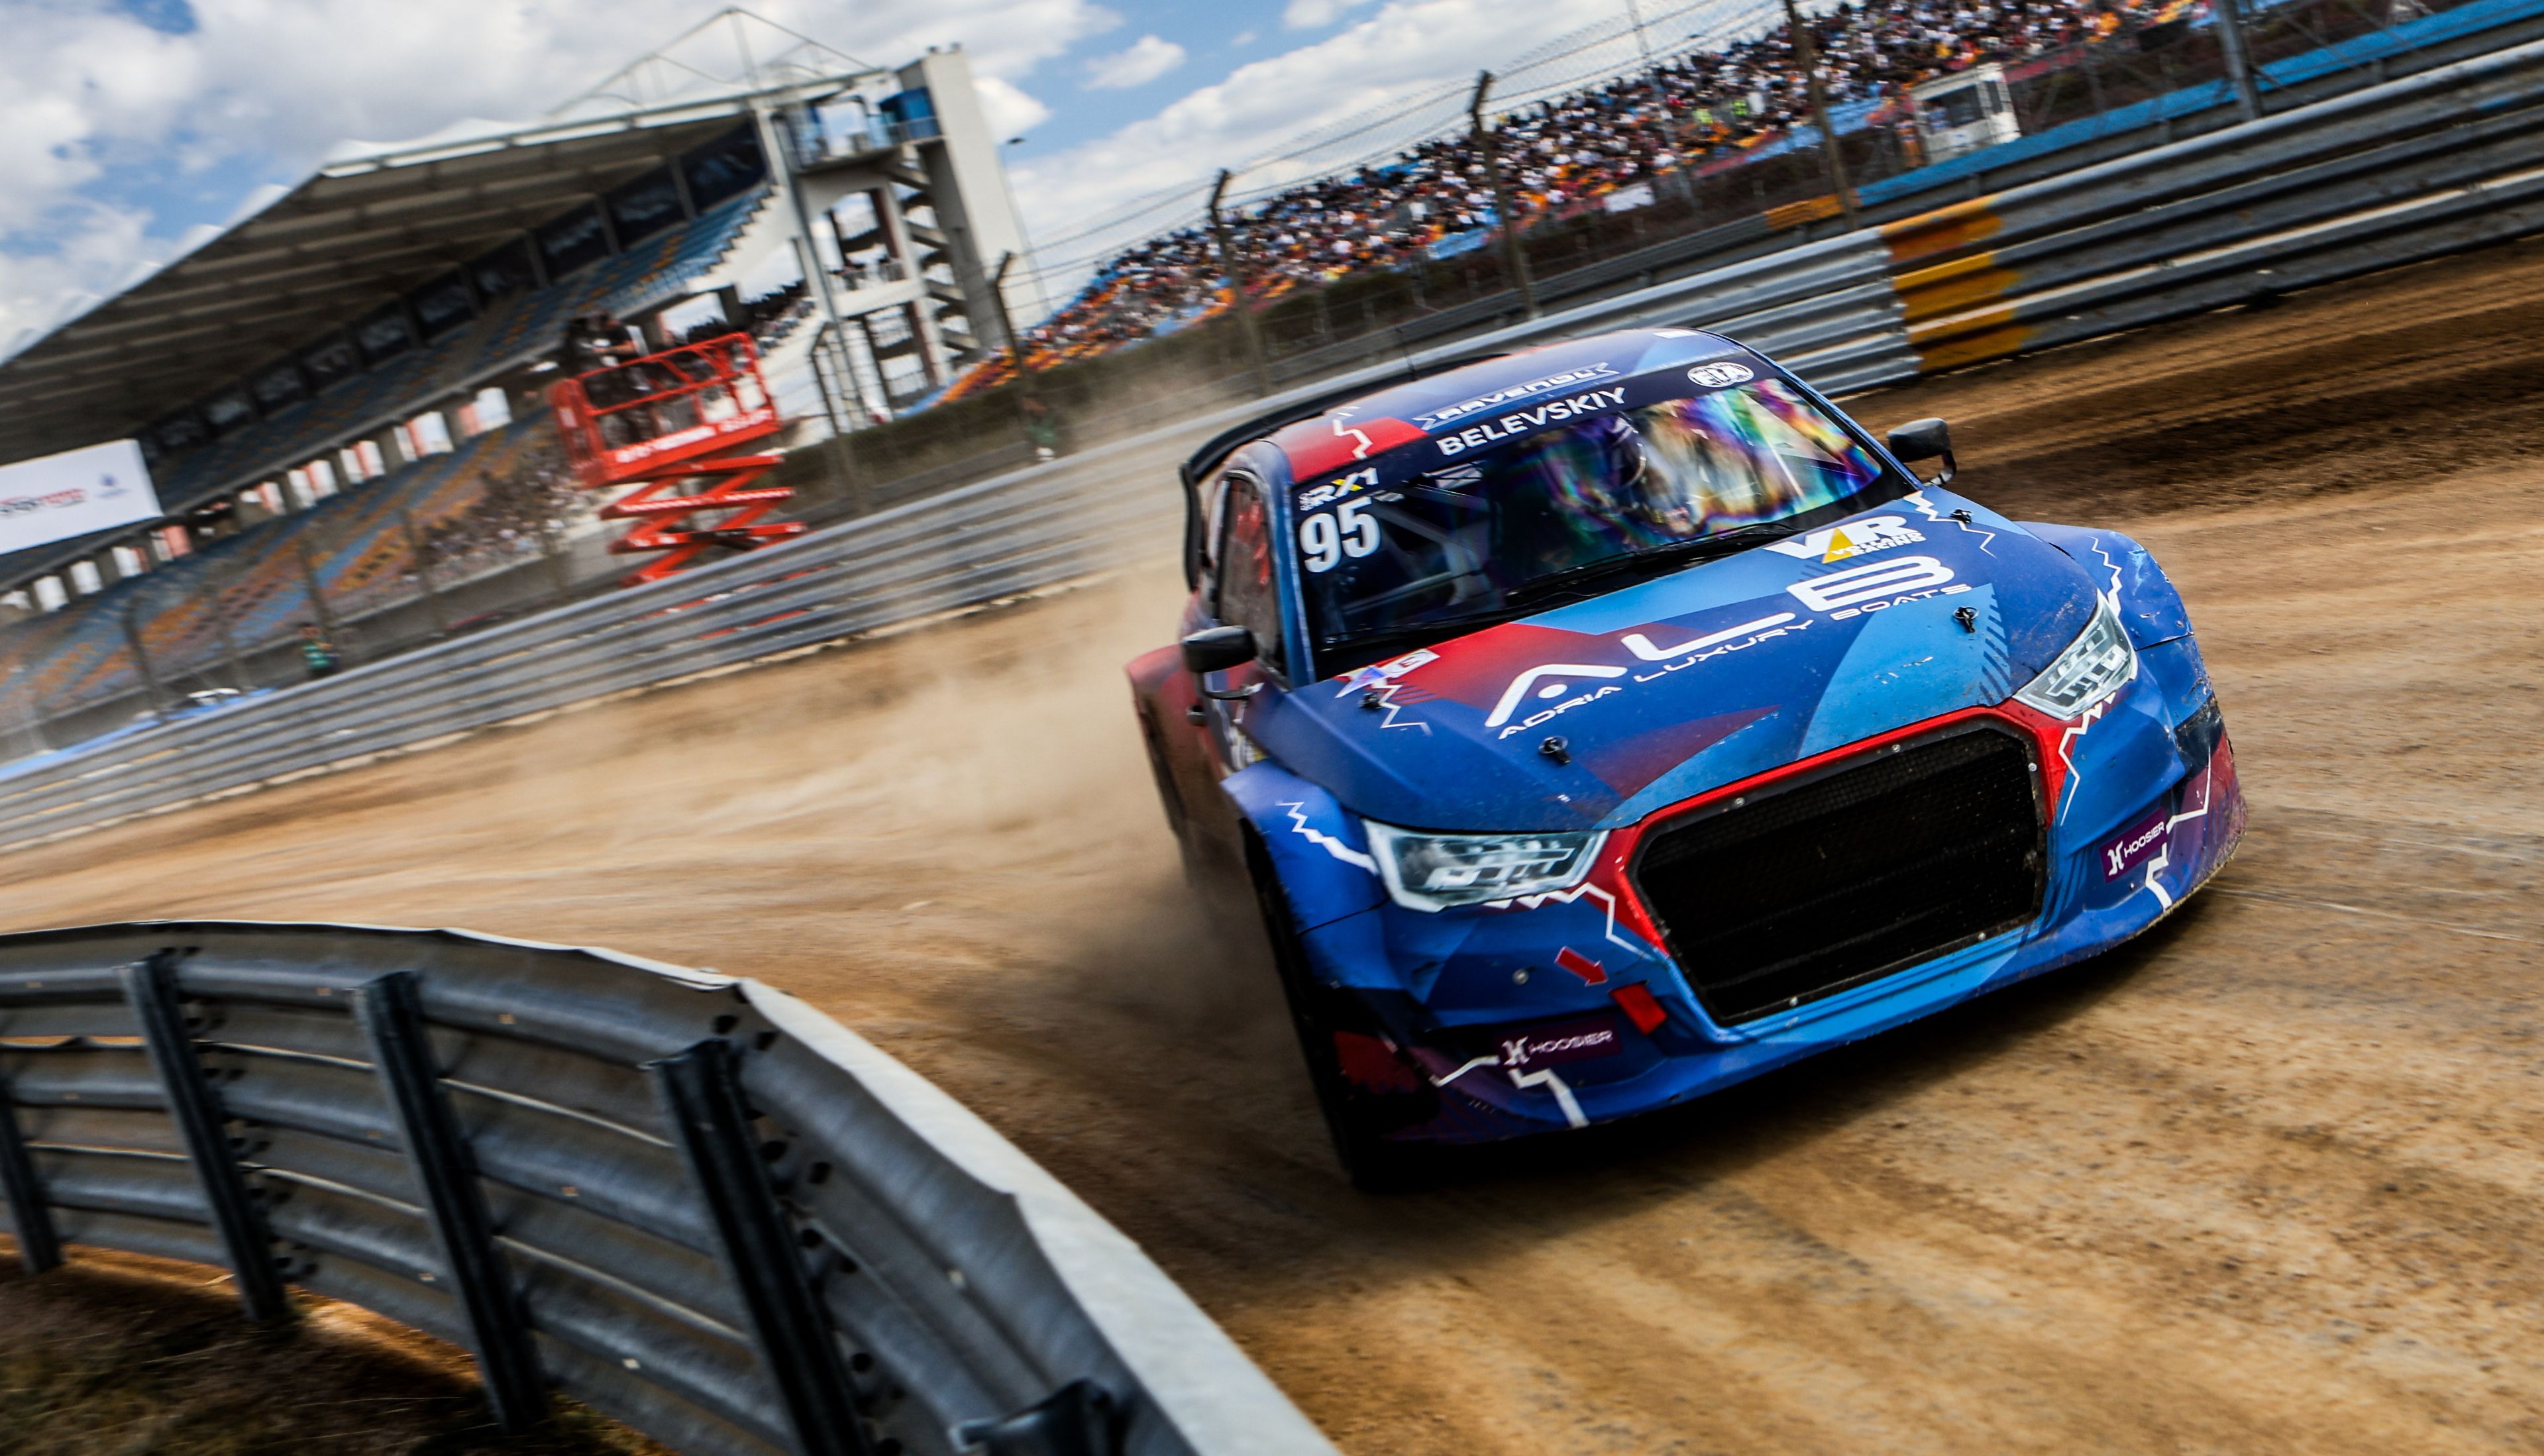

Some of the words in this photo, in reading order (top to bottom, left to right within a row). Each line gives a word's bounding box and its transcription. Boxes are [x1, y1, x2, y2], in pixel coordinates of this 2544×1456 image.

[1691, 364, 1749, 386] FIA
[1436, 387, 1626, 456] BELEVSKIY
[1308, 467, 1379, 506] RX1
[1300, 496, 1381, 572] 95
[1830, 531, 1923, 556] VOLLAND
[1850, 534, 1927, 556] RACING
[1499, 686, 1622, 739] ADRIA
[1634, 619, 1814, 683] LUXURY
[1830, 584, 1972, 621] BOATS
[2123, 821, 2164, 858] HOOSIER
[1528, 1030, 1613, 1055] HOOSIER
